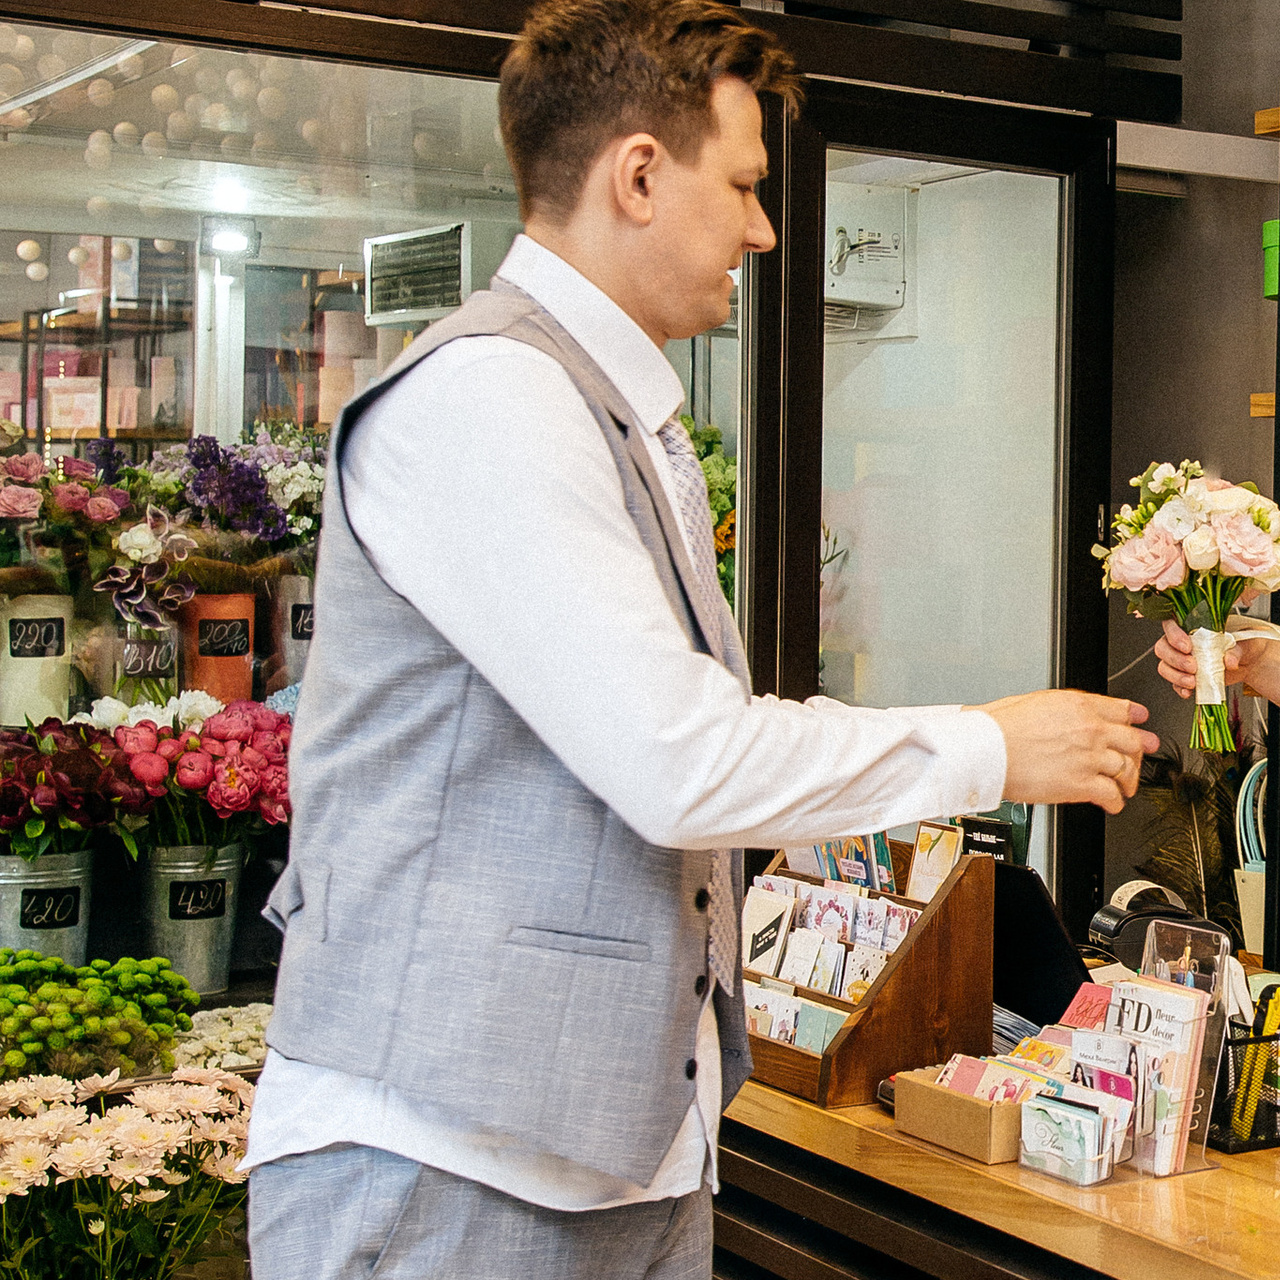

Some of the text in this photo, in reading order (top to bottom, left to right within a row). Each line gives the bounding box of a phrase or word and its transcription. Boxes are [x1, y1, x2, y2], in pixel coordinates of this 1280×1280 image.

[11, 622, 56, 650] 220
[199, 621, 242, 647] 200
[24, 894, 75, 925] 420
[178, 882, 222, 915] 420
[1114, 997, 1153, 1033] FD
